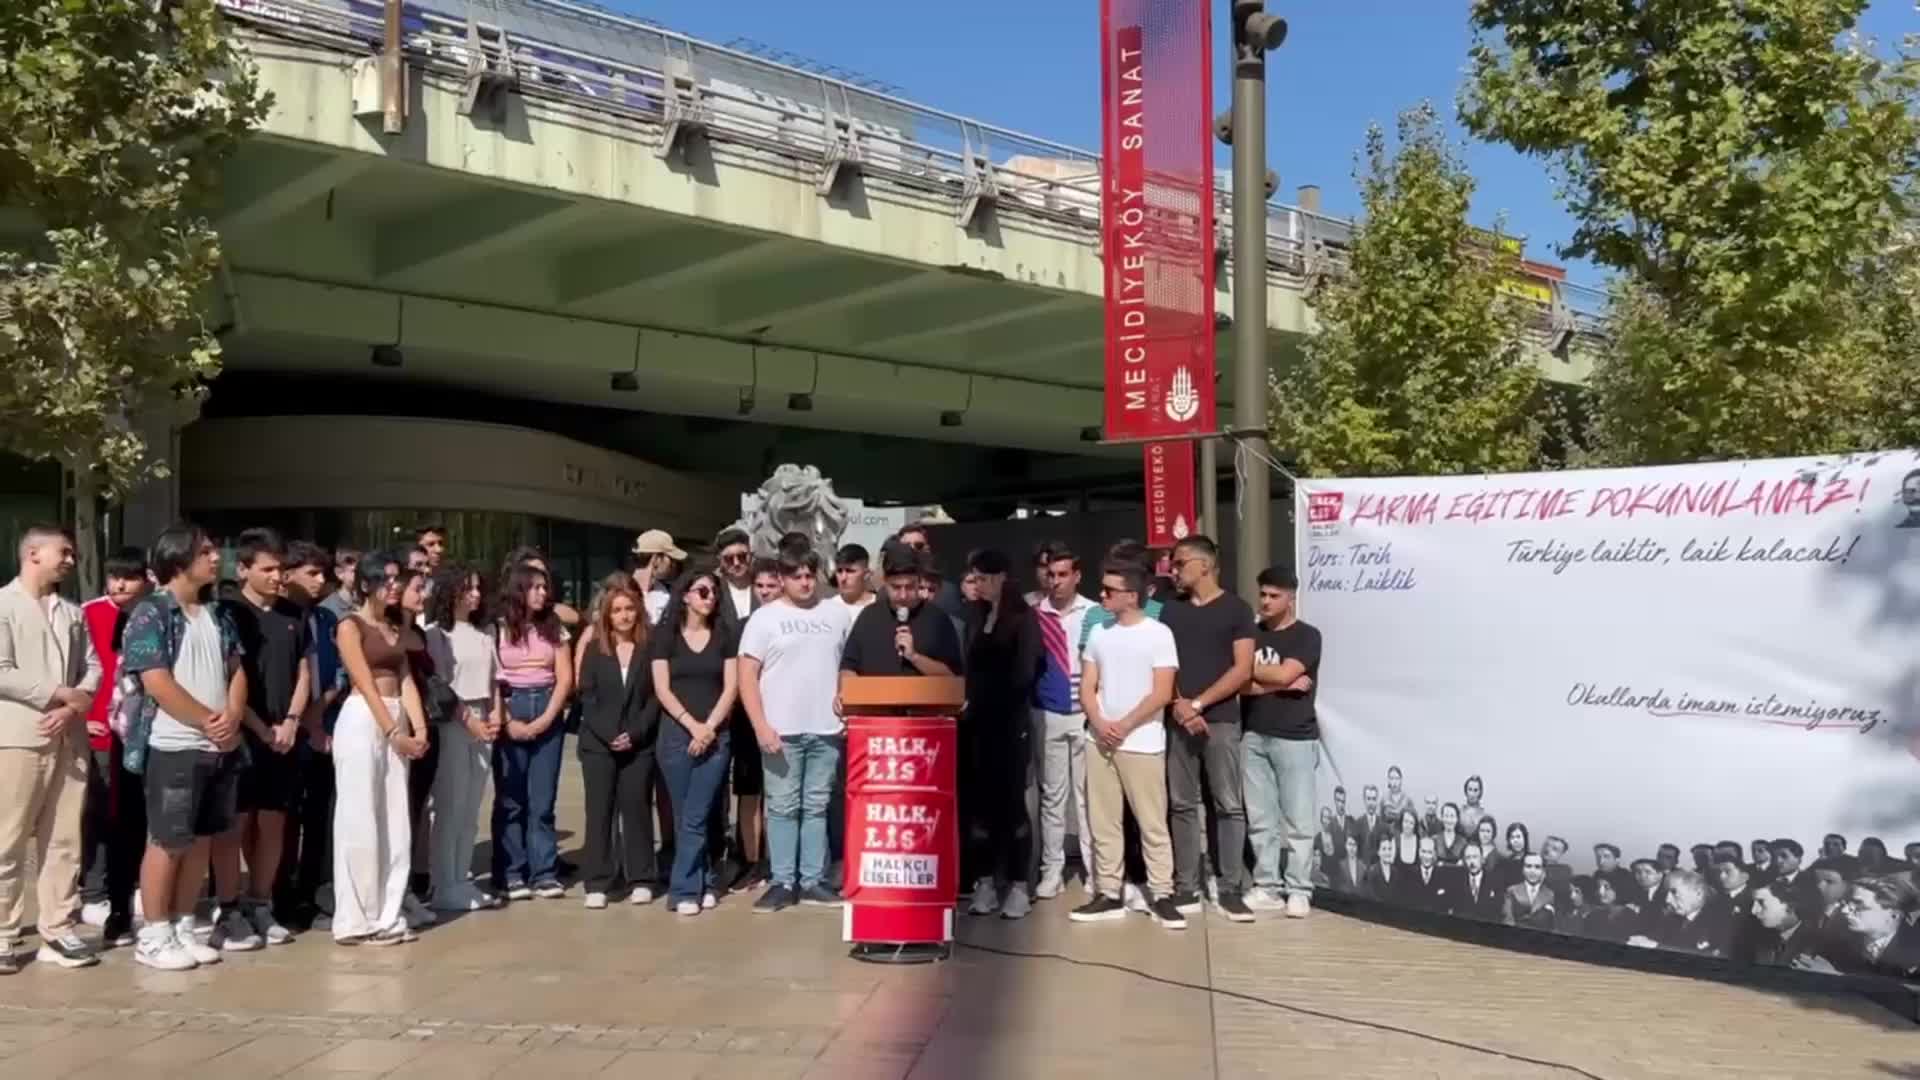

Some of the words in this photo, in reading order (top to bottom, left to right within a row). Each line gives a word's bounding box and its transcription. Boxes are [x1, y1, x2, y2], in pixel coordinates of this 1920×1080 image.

[1121, 47, 1143, 151] SANAT
[1119, 187, 1146, 411] MECİDİYEKÖY
[1350, 492, 1440, 527] KARMA
[1308, 545, 1345, 568] Ders:
[1347, 542, 1393, 567] Tarih
[1506, 539, 1587, 575] Türkiye
[1590, 537, 1671, 566] laiktir,
[1680, 536, 1732, 562] laik
[1735, 535, 1861, 565] kalacak!
[1352, 567, 1417, 593] Laiklik
[780, 619, 833, 635] BOSS
[1567, 682, 1672, 710] Okullarda
[1677, 692, 1738, 714] imam
[1746, 693, 1888, 733] istemiyoruz.
